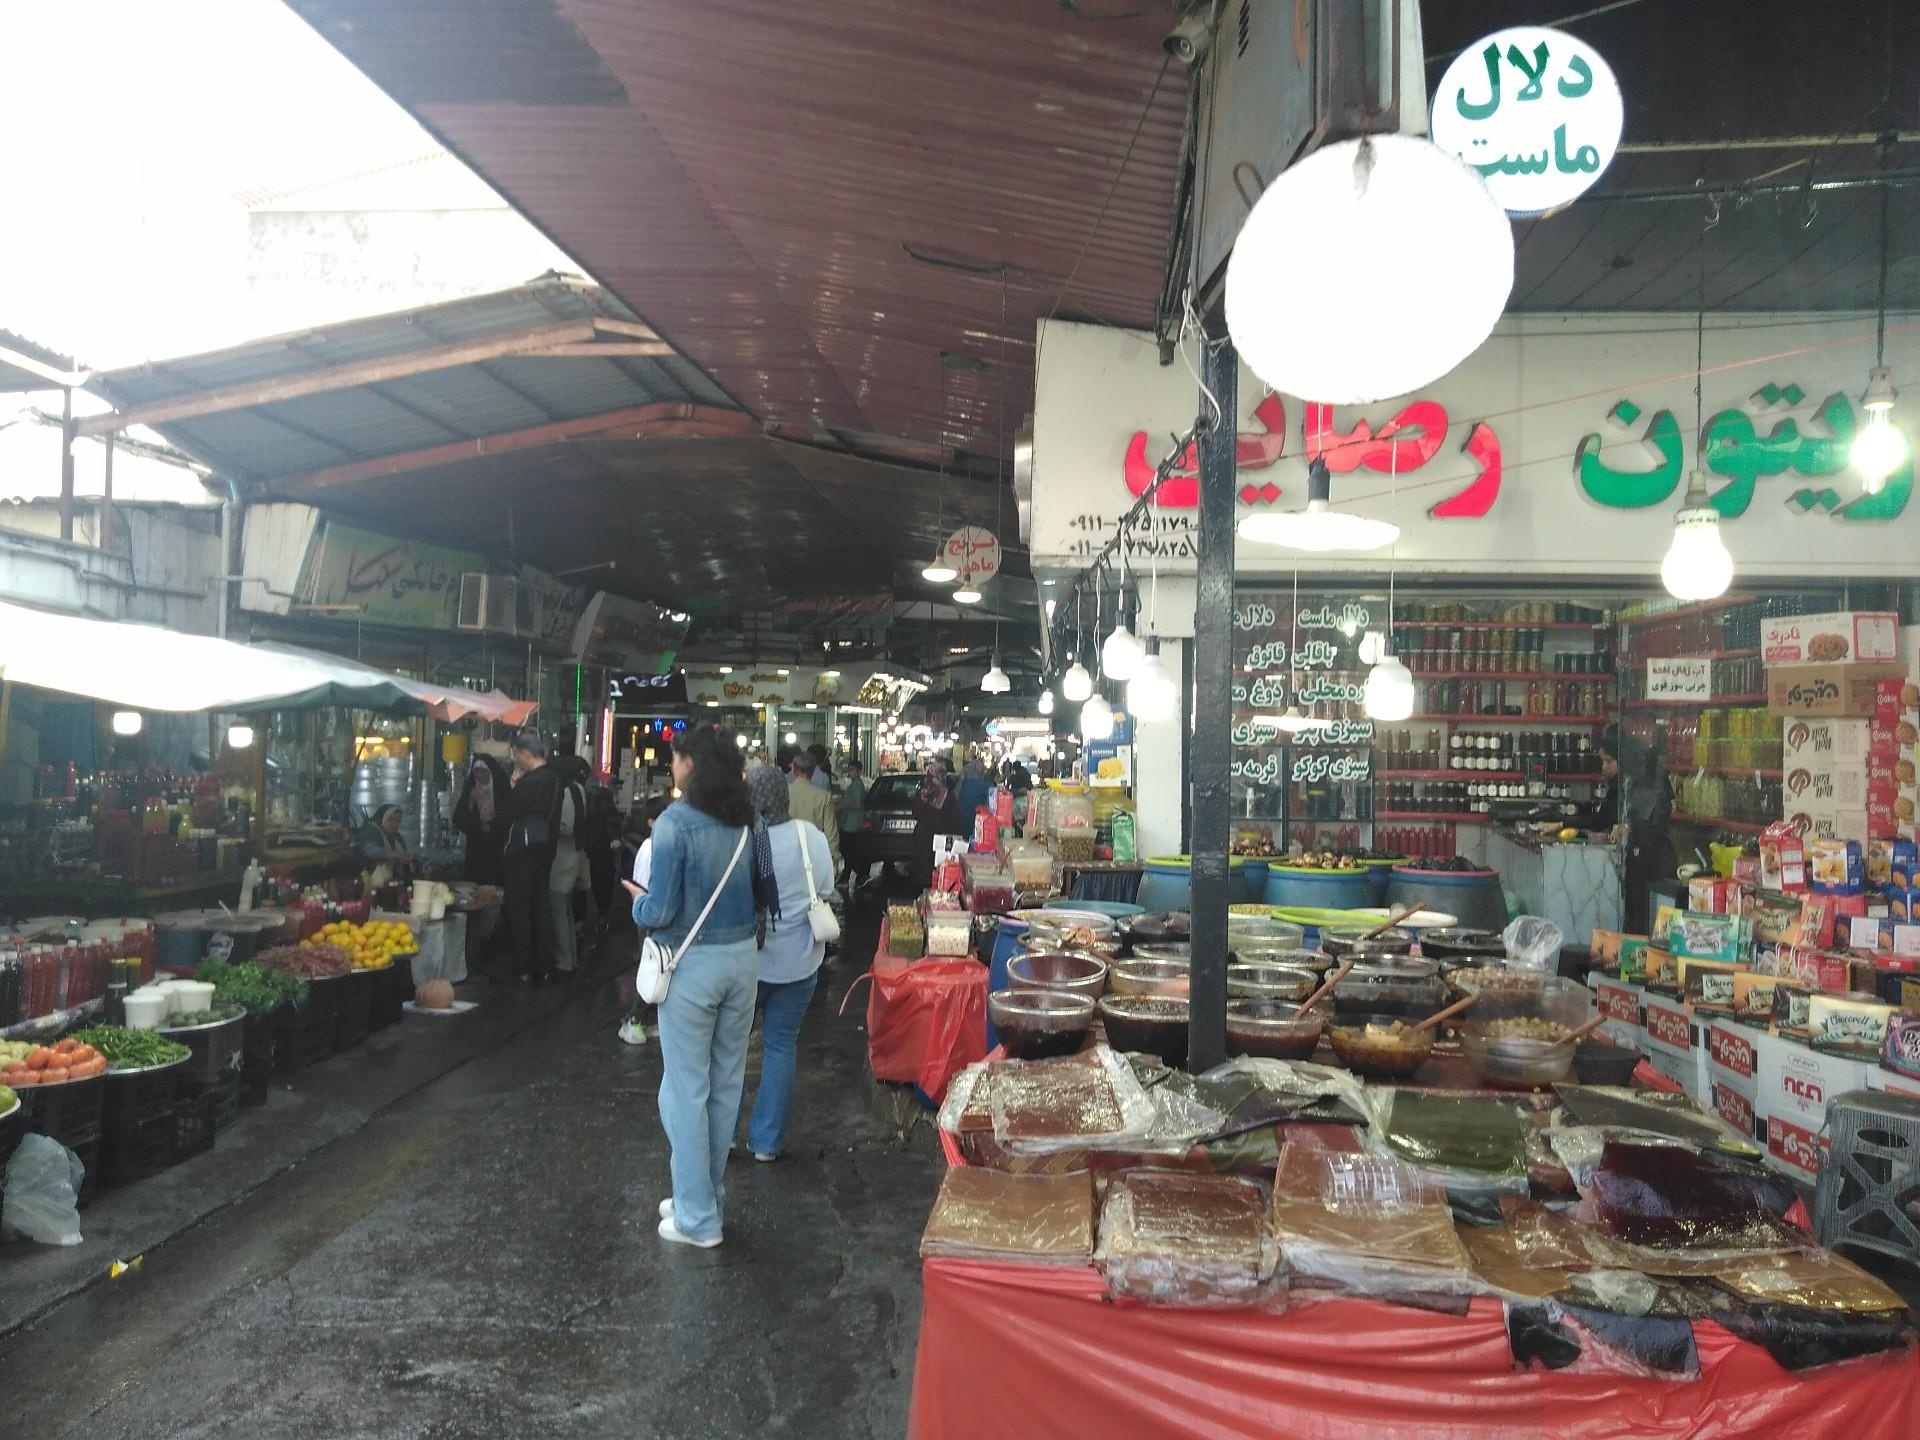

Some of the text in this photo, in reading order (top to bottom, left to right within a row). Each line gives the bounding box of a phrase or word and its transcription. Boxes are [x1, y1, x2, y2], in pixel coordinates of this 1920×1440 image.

[1456, 41, 1593, 120] دلال
[1457, 123, 1600, 178] ماست
[1241, 603, 1275, 630] دلال
[1298, 603, 1370, 631] دلال ماست
[1247, 641, 1286, 668] قاتوق
[1250, 678, 1283, 707] دوغ
[1299, 676, 1368, 705] ره محلی
[1322, 718, 1373, 743] سبزی
[1243, 754, 1278, 784] قرمه
[1292, 754, 1370, 783] سبزی کوکو
